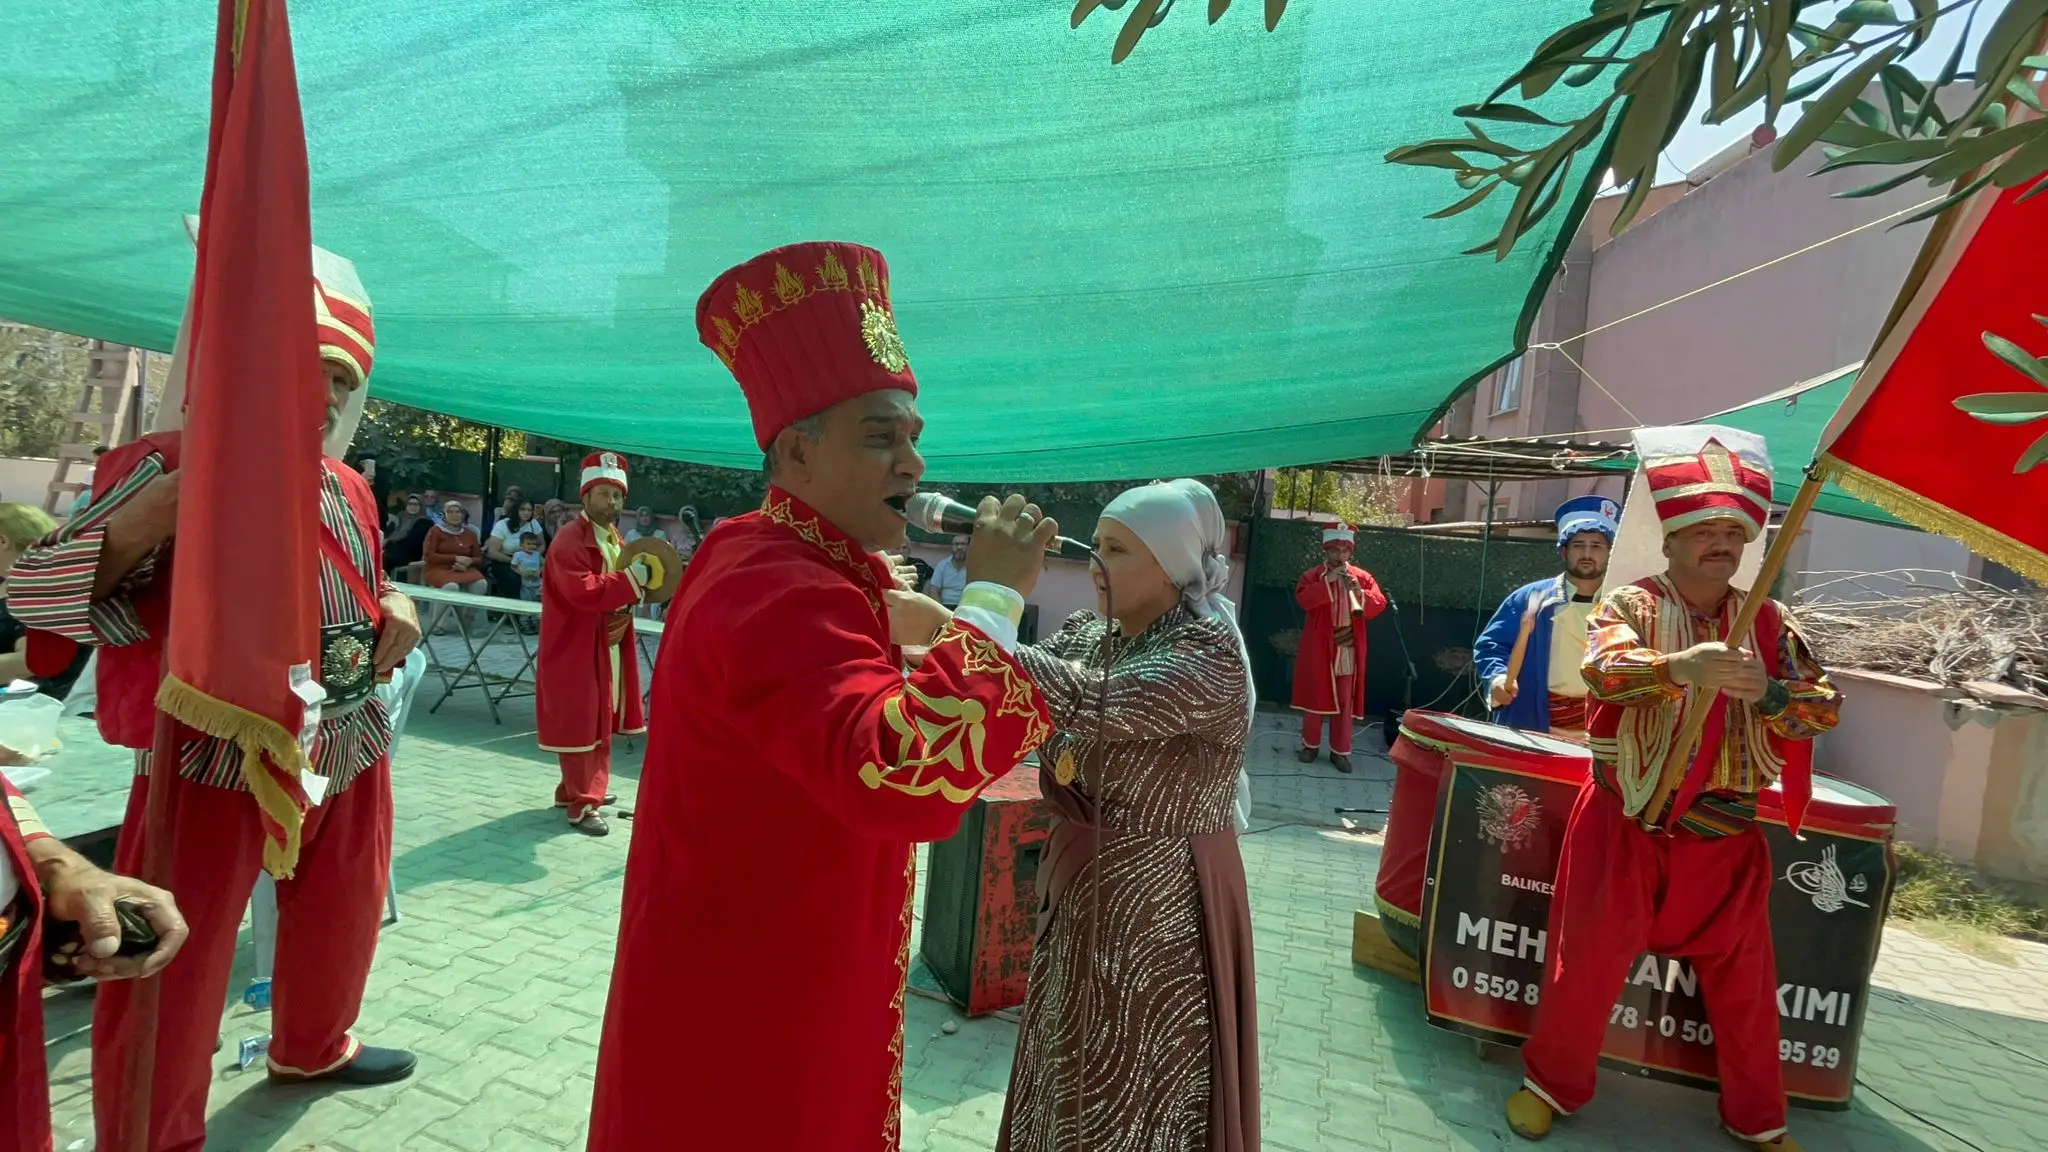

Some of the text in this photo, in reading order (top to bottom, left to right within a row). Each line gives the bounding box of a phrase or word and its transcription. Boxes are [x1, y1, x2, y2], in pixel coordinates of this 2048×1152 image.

[1452, 966, 1468, 988] 0
[1474, 971, 1520, 1001] 552
[1609, 1003, 1638, 1029] 78
[1660, 1015, 1676, 1037] 0
[1681, 1019, 1714, 1046] 50
[1779, 1038, 1807, 1064] 95
[1811, 1044, 1840, 1069] 29
[1776, 983, 1850, 1027] KIMI
